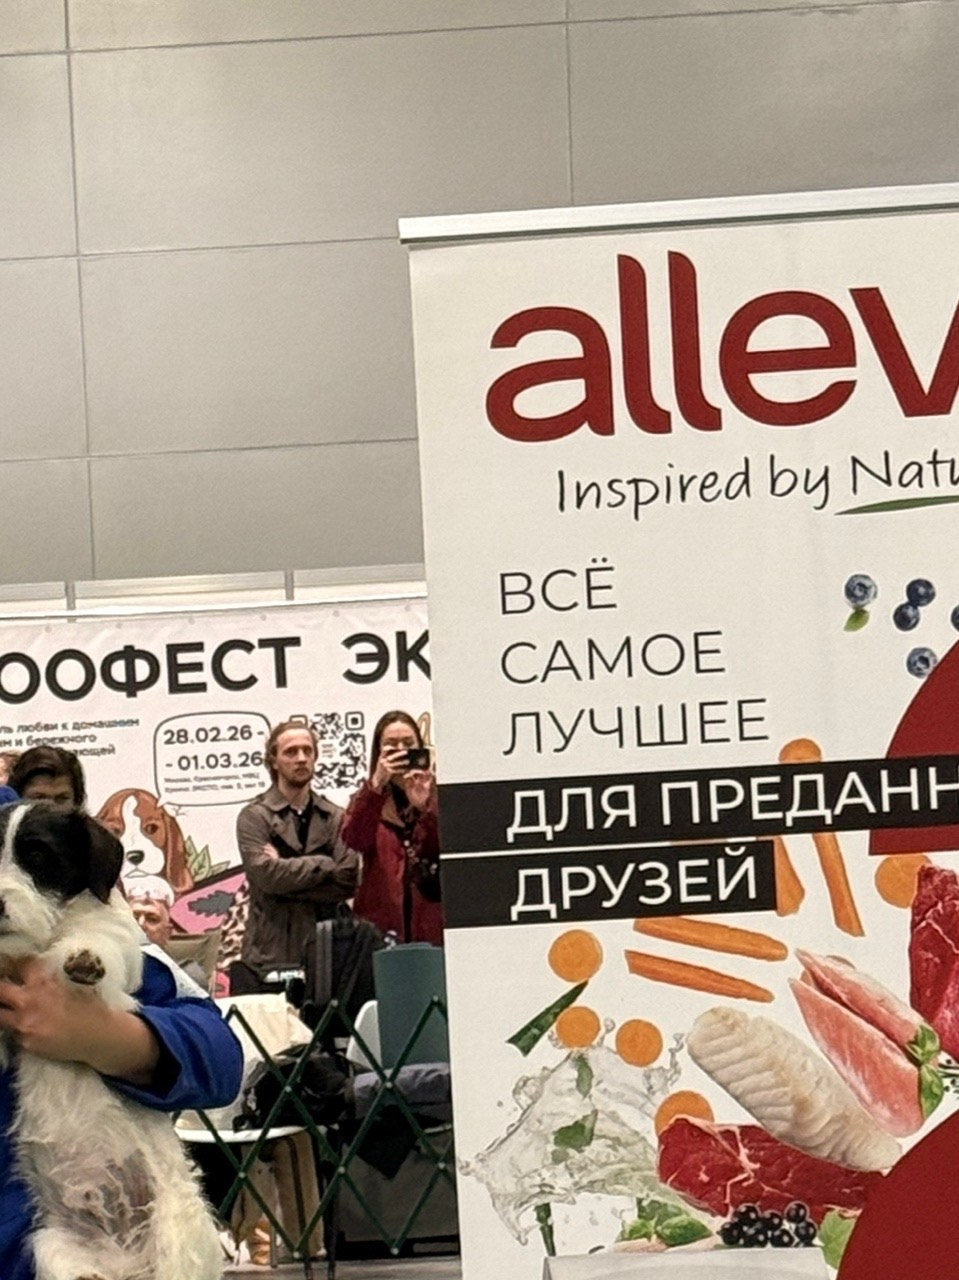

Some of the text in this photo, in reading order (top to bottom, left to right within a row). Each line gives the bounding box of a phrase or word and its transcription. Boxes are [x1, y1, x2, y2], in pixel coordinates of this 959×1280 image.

[485, 250, 959, 442] allev
[556, 457, 751, 521] Inspired
[768, 454, 830, 510] by
[500, 557, 617, 615] ВСЁ
[501, 630, 725, 684] САМОЕ
[17, 721, 58, 734] любви
[163, 725, 253, 745] 28.02.26
[502, 698, 770, 756] ЛУЧШЕЕ
[177, 751, 263, 771] 01.03.26
[506, 784, 638, 844] ДЛЯ
[510, 836, 757, 922] ДРУЗЕЙ
